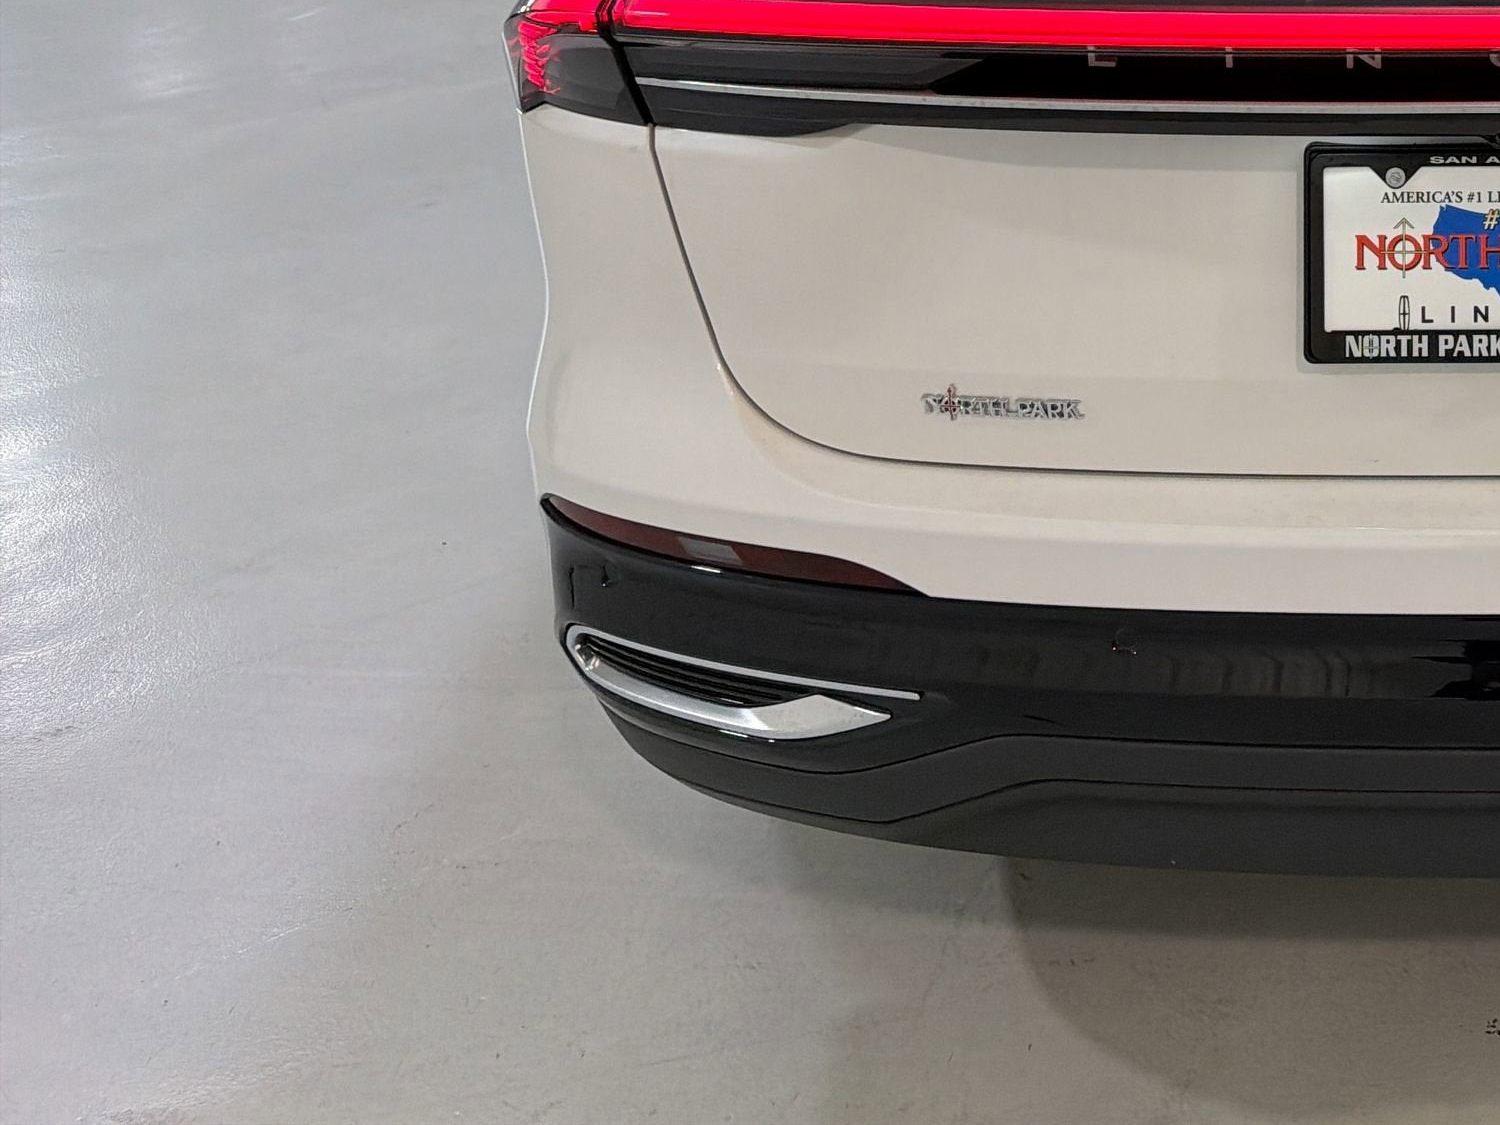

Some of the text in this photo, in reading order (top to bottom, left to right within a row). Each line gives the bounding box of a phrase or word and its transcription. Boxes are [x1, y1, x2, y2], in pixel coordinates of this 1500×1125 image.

[1429, 155, 1478, 165] SAN
[1380, 190, 1463, 204] AMERICA'S
[1466, 191, 1482, 204] #1
[1345, 334, 1429, 359] NORTH
[921, 391, 1085, 419] NORTH PARK
